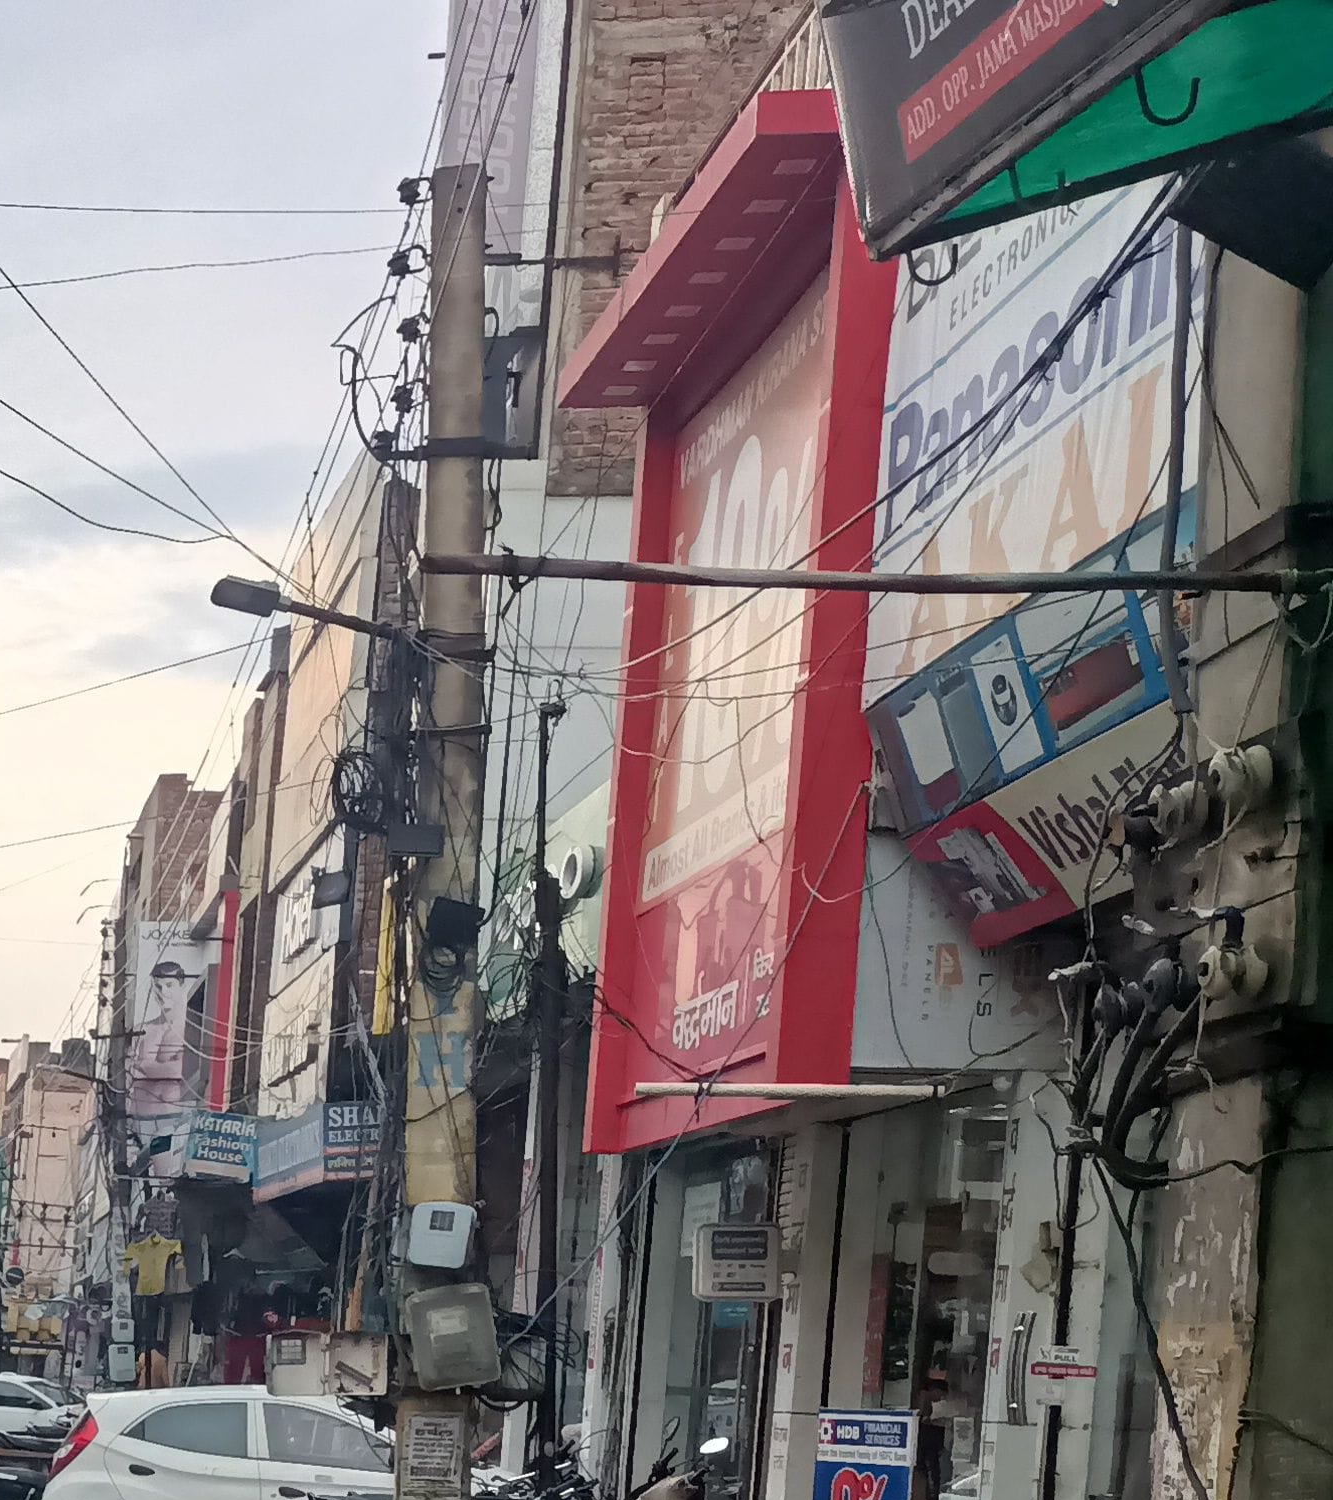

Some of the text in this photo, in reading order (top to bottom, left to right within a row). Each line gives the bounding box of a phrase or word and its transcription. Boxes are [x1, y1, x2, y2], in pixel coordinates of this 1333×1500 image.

[901, 0, 978, 59] DEA
[906, 97, 941, 144] ADD.
[941, 65, 976, 112] OPP.
[975, 33, 1018, 89] JAMA
[646, 843, 690, 892] Almost
[327, 1104, 381, 1128] SHA
[194, 1133, 254, 1153] Fashion
[196, 1146, 244, 1164] House
[1053, 1353, 1078, 1364] PULL
[836, 1426, 860, 1441] HDB
[863, 1421, 902, 1435] FINANCIAL
[864, 1433, 901, 1447] SERVICES
